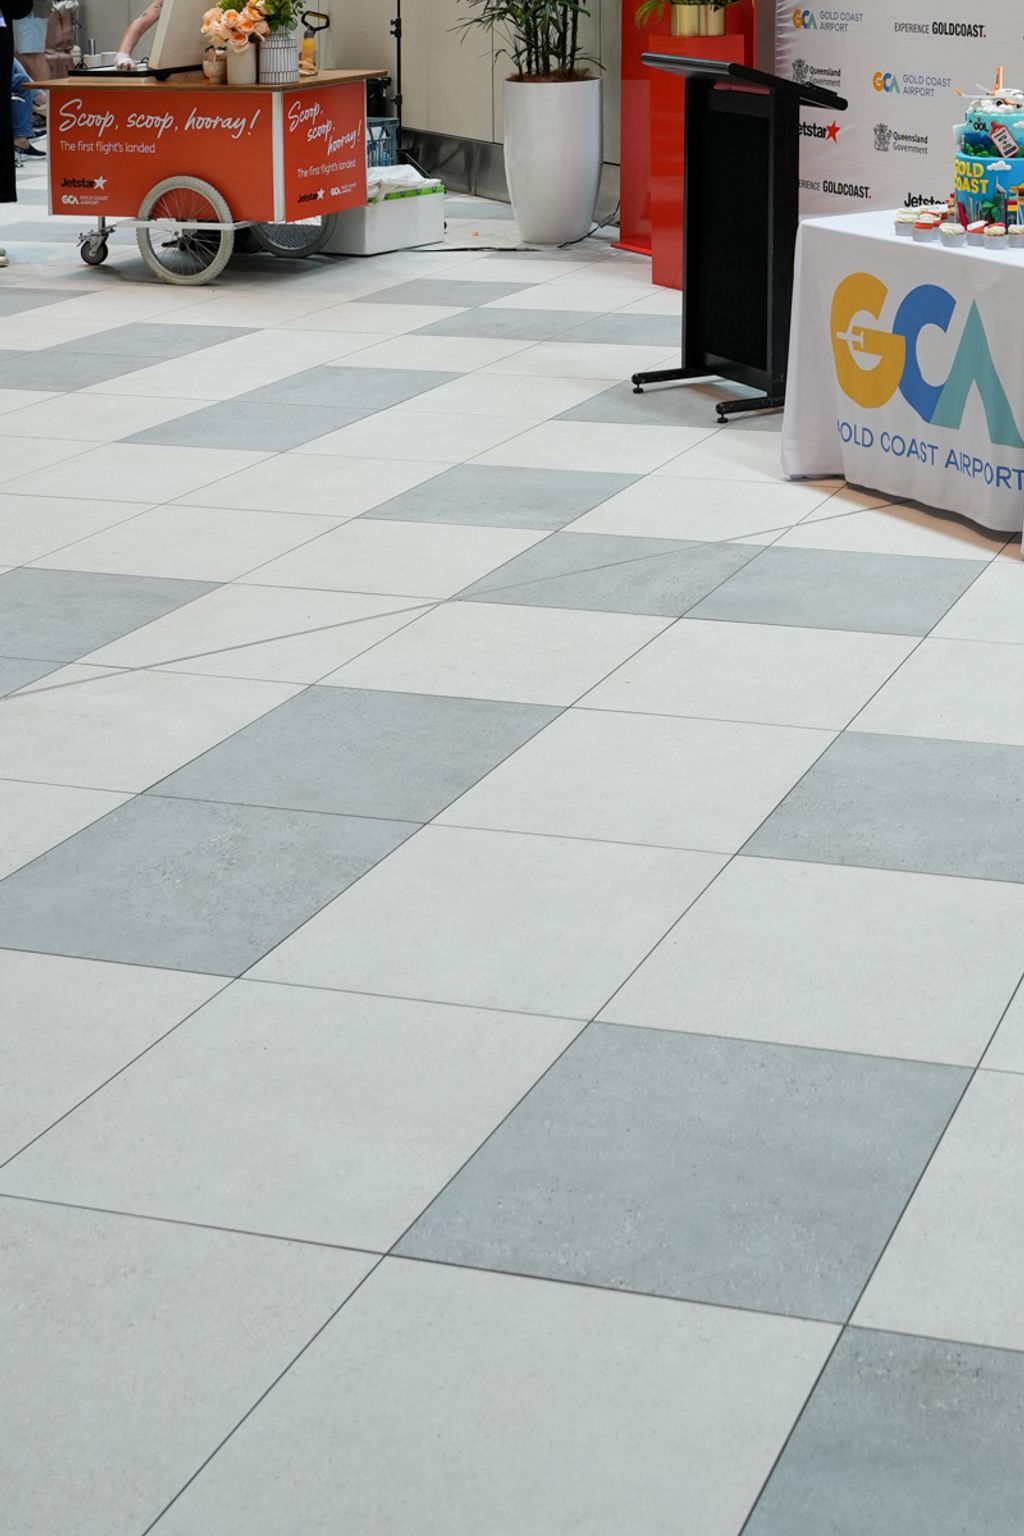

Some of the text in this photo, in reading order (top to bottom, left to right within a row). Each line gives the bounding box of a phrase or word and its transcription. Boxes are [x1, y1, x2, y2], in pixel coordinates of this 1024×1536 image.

[793, 9, 818, 30] GCA
[820, 10, 864, 22] GOLD COAST
[820, 22, 848, 32] AIRPORT
[894, 22, 929, 34] EXPERIENCE
[810, 66, 841, 76] Queensland
[872, 71, 900, 93] GCA
[902, 74, 952, 88] GOLD COAST
[902, 86, 936, 97] AIRPORT
[59, 98, 261, 140] Scoop, scoop, hooray!
[799, 122, 826, 138] etstar
[893, 131, 928, 144] Queensland
[59, 140, 156, 155] The first flight's landed
[893, 142, 928, 154] Government
[61, 178, 95, 188] Jetstar
[880, 432, 938, 466] COAST
